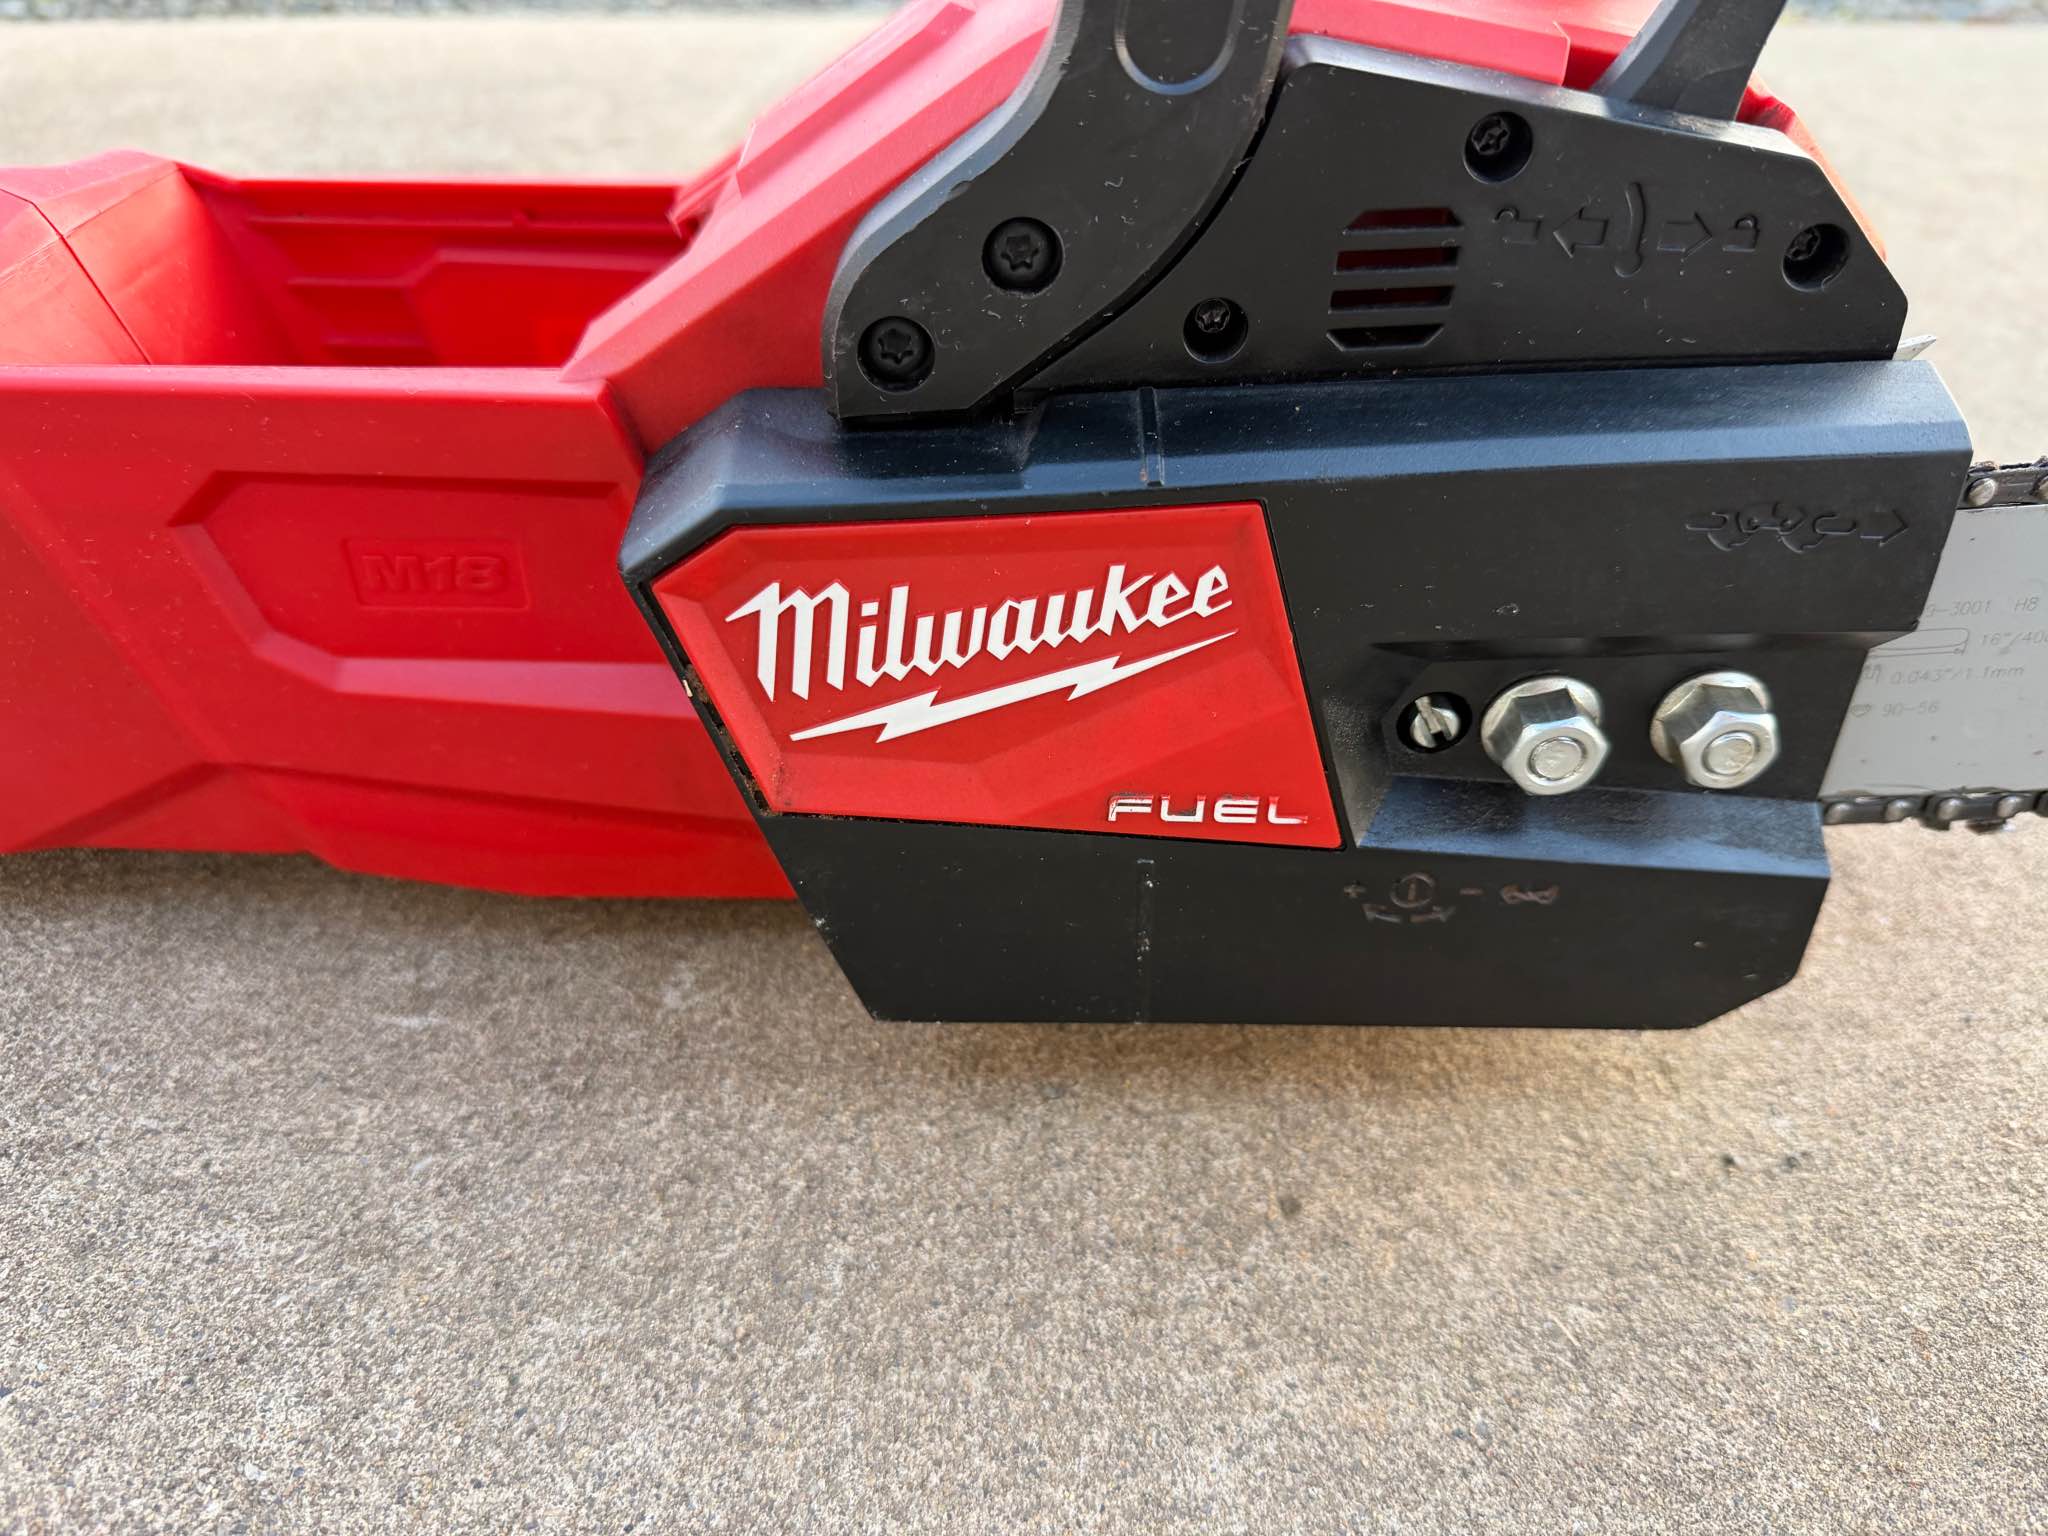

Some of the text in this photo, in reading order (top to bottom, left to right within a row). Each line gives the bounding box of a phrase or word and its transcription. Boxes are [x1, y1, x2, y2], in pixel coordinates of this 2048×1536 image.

[362, 554, 506, 592] M18
[725, 563, 1232, 702] Milwaukee
[1108, 793, 1309, 825] FUEL
